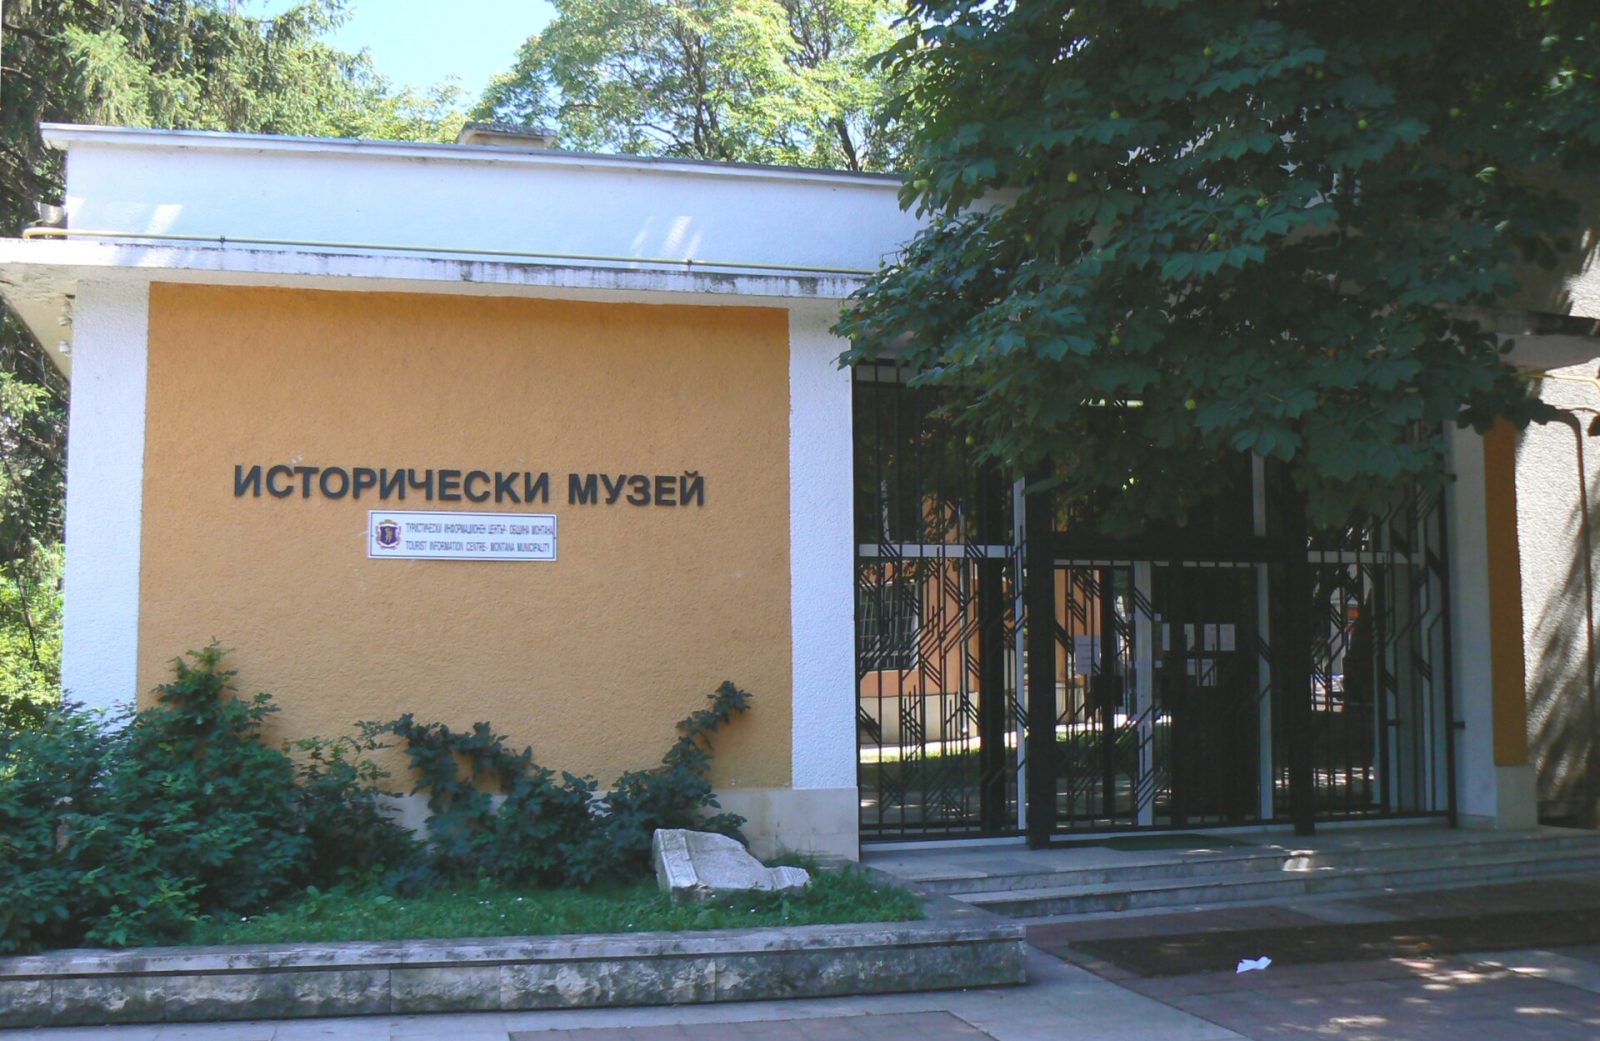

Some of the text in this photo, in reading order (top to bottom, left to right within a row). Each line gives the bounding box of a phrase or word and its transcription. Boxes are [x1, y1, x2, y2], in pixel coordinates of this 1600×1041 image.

[233, 464, 705, 507] ИСТОРИЧЕСКИ МУЗЕЙ
[405, 540, 427, 551] TOURIST
[429, 541, 464, 552] INFORMATION
[490, 542, 515, 552] MONTANA
